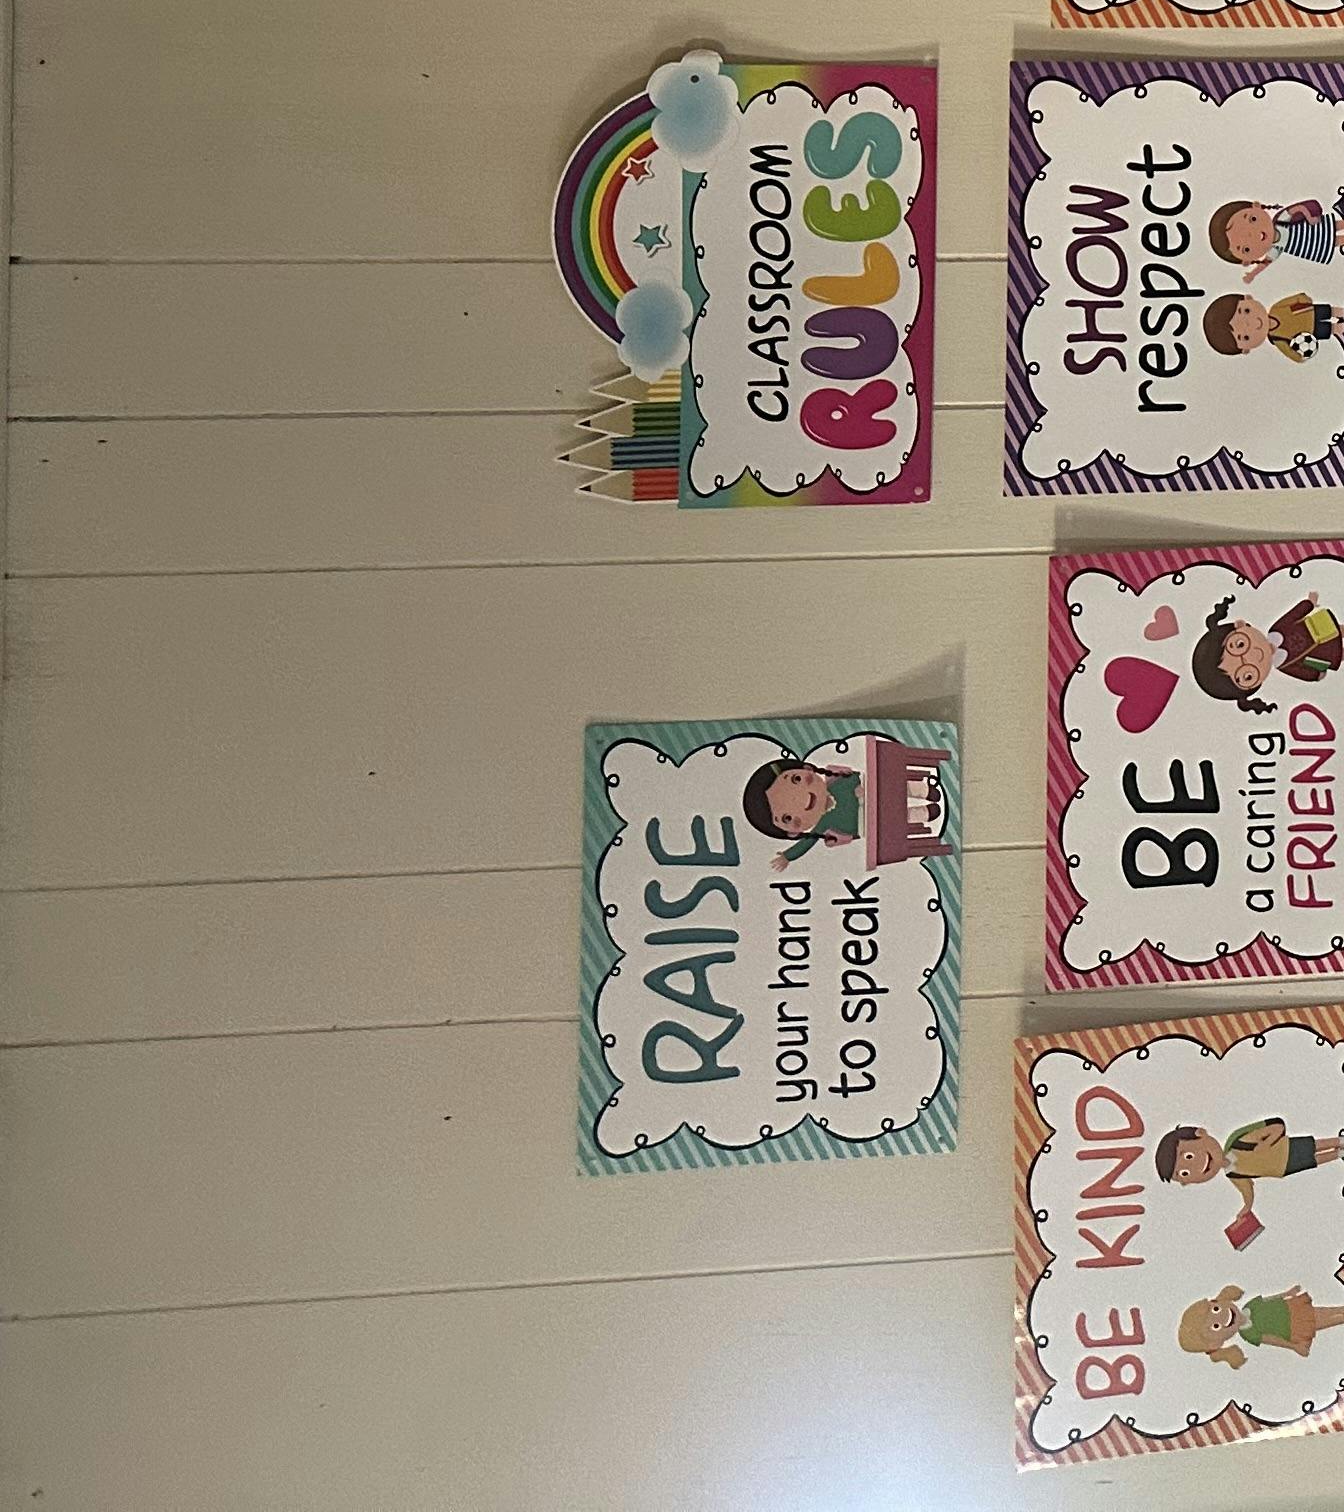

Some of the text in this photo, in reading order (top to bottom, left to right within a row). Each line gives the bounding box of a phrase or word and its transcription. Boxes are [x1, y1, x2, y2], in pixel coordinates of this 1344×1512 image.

[746, 144, 796, 422] CLASSROOM
[800, 111, 903, 450] RULES
[1063, 184, 1130, 376] SHOW
[1126, 143, 1205, 413] respect
[1121, 759, 1220, 889] BE
[1238, 732, 1285, 912] a caring
[1286, 703, 1338, 910] FRIEND
[640, 814, 744, 1084] RAISE
[767, 881, 817, 1102] your hand
[827, 877, 889, 1098] to speak
[1074, 1085, 1146, 1400] BE KIND
